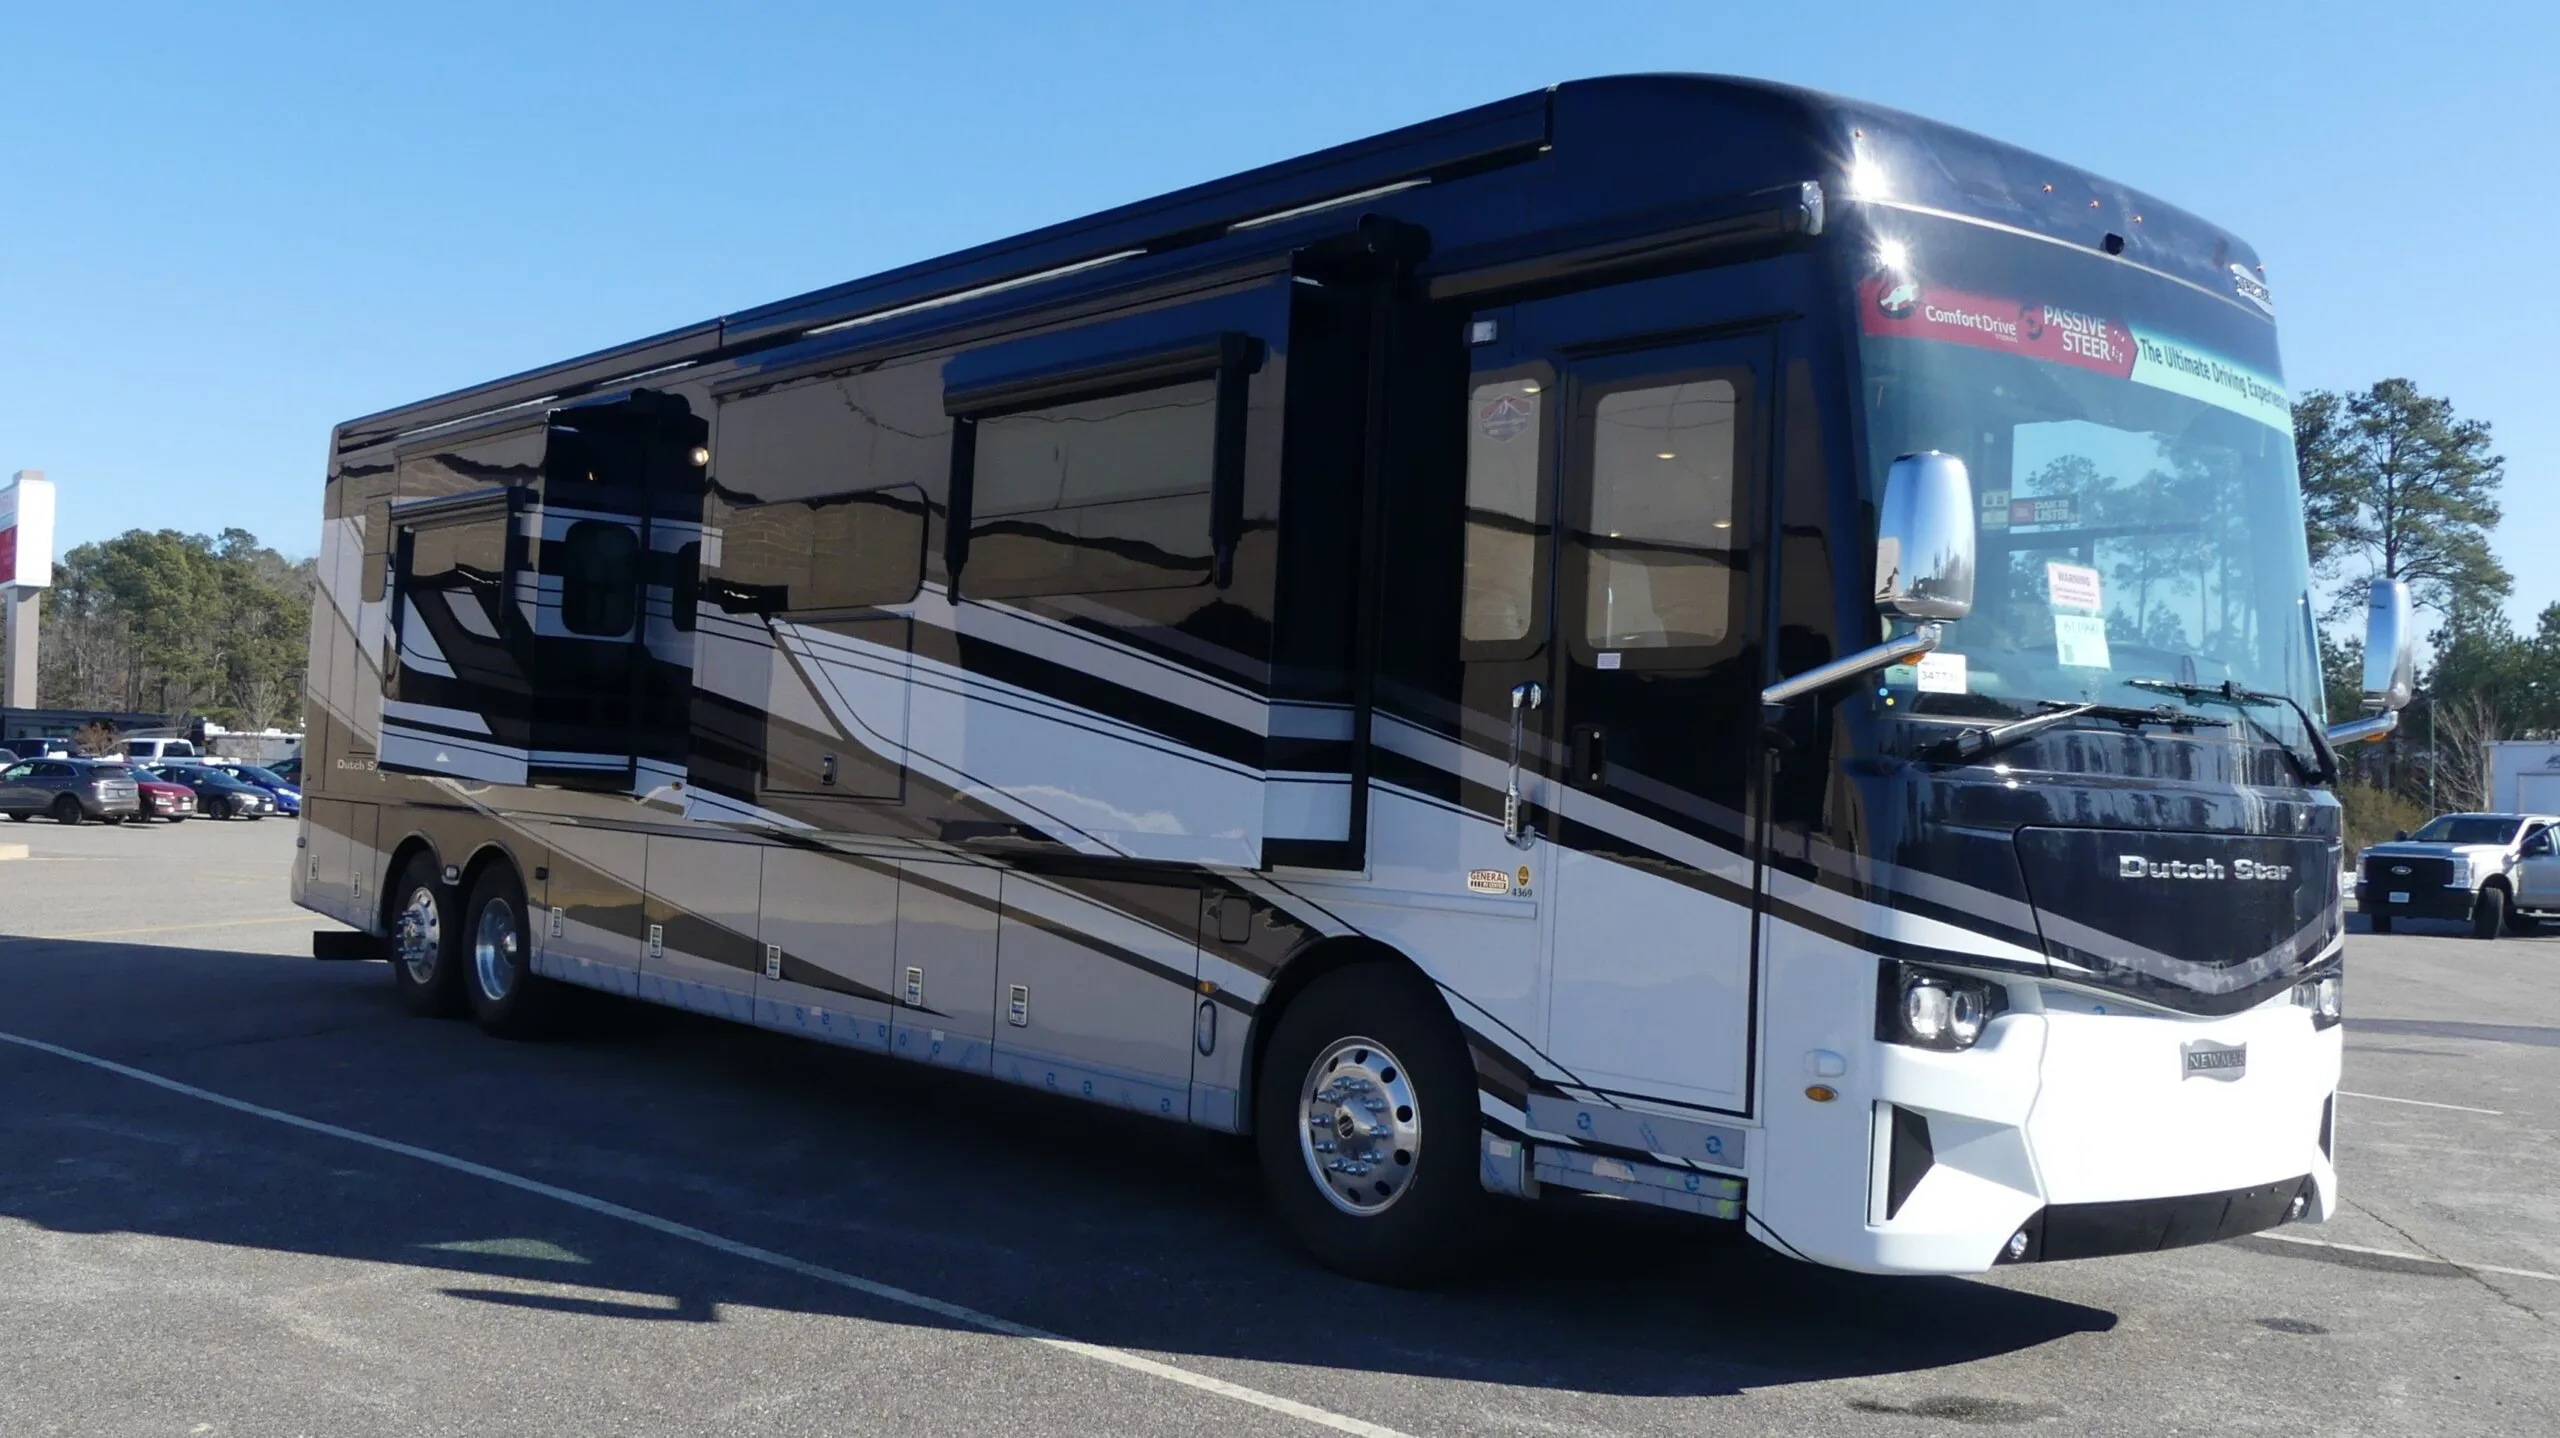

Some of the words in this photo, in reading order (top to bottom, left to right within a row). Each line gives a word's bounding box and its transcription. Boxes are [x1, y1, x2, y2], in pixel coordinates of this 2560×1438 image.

[1925, 305, 2017, 336] ComfortDrive
[2044, 305, 2107, 338] PASSIVE
[2062, 330, 2111, 361] STEER
[2140, 338, 2163, 365] The
[2164, 345, 2211, 380] Ultimate
[2211, 361, 2247, 398] Driving
[337, 760, 364, 770] Dutch
[1470, 872, 1506, 881] GENERAL
[2119, 855, 2226, 880] Dutch
[2233, 858, 2293, 881] Star
[1512, 888, 1532, 897] 4369
[2188, 1050, 2246, 1069] NEWMAR
